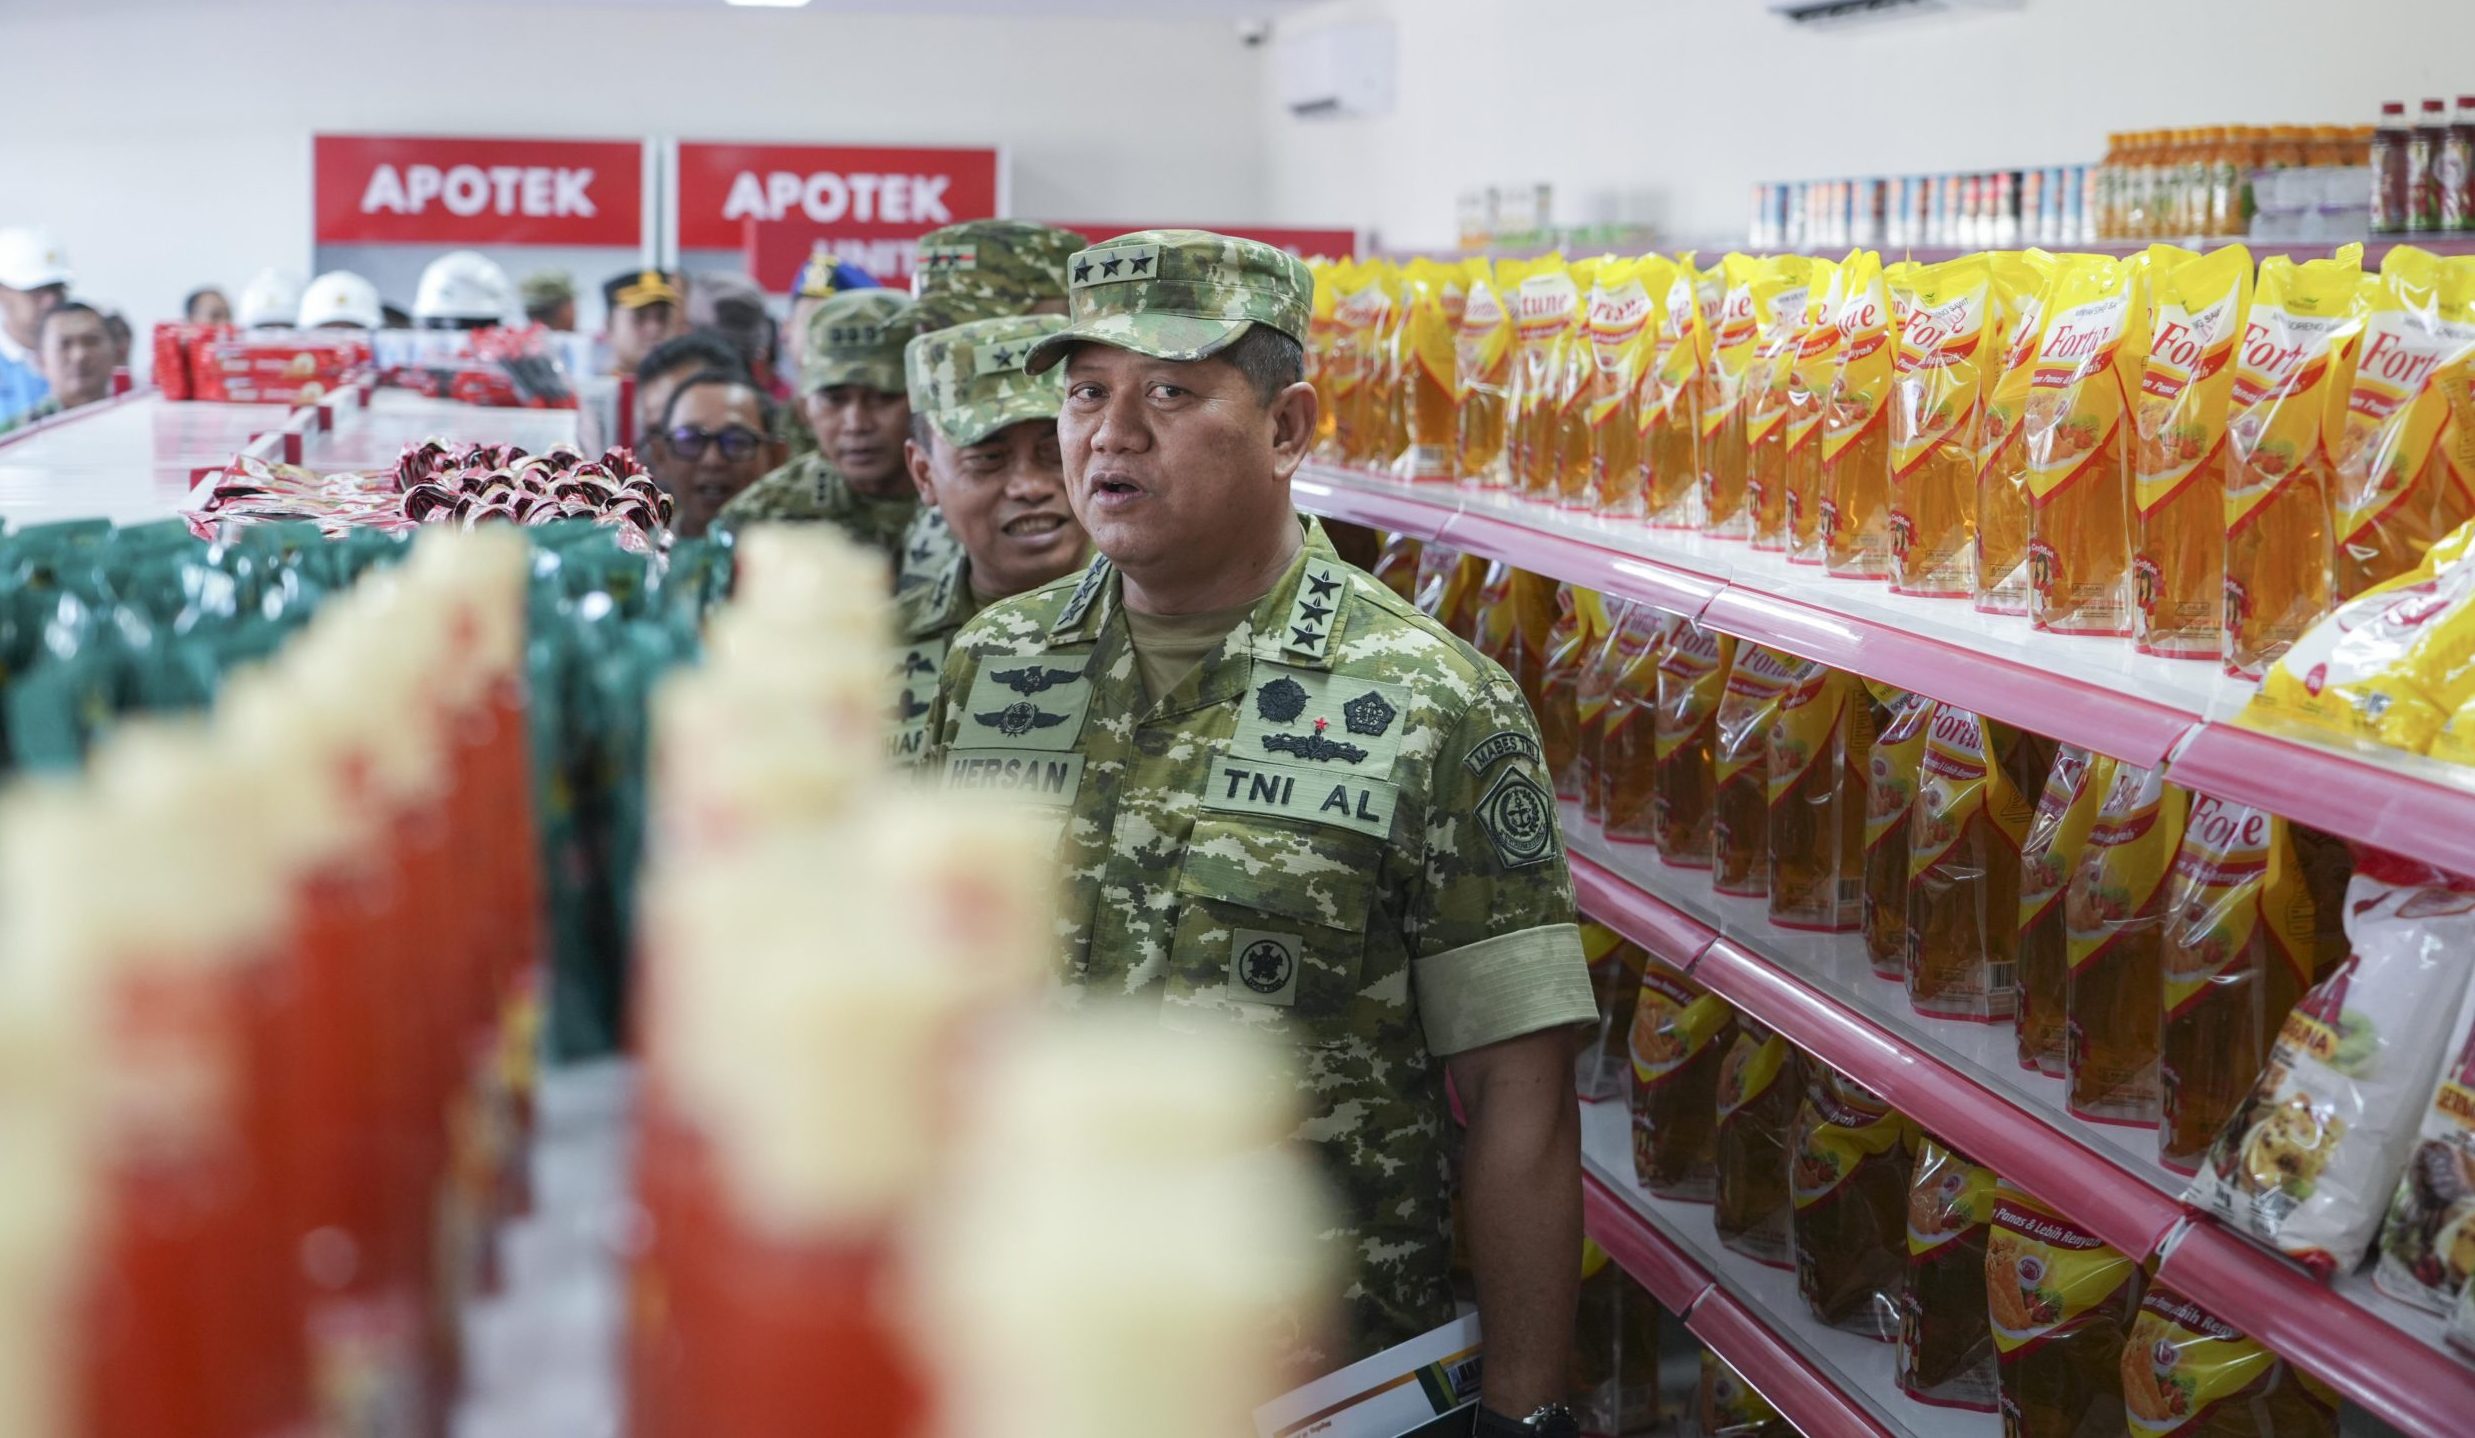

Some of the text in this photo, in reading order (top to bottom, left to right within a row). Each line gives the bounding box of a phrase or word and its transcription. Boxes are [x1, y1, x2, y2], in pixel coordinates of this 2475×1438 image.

[361, 163, 597, 218] APOTEK
[722, 170, 952, 224] APOTEK
[1475, 737, 1536, 767] MABES TNI
[951, 758, 1068, 794] HERSAN
[1224, 768, 1380, 822] TNI AL
[1995, 1207, 2027, 1227] Panas
[2026, 1219, 2037, 1231] &
[2034, 1222, 2063, 1240] Lebih
